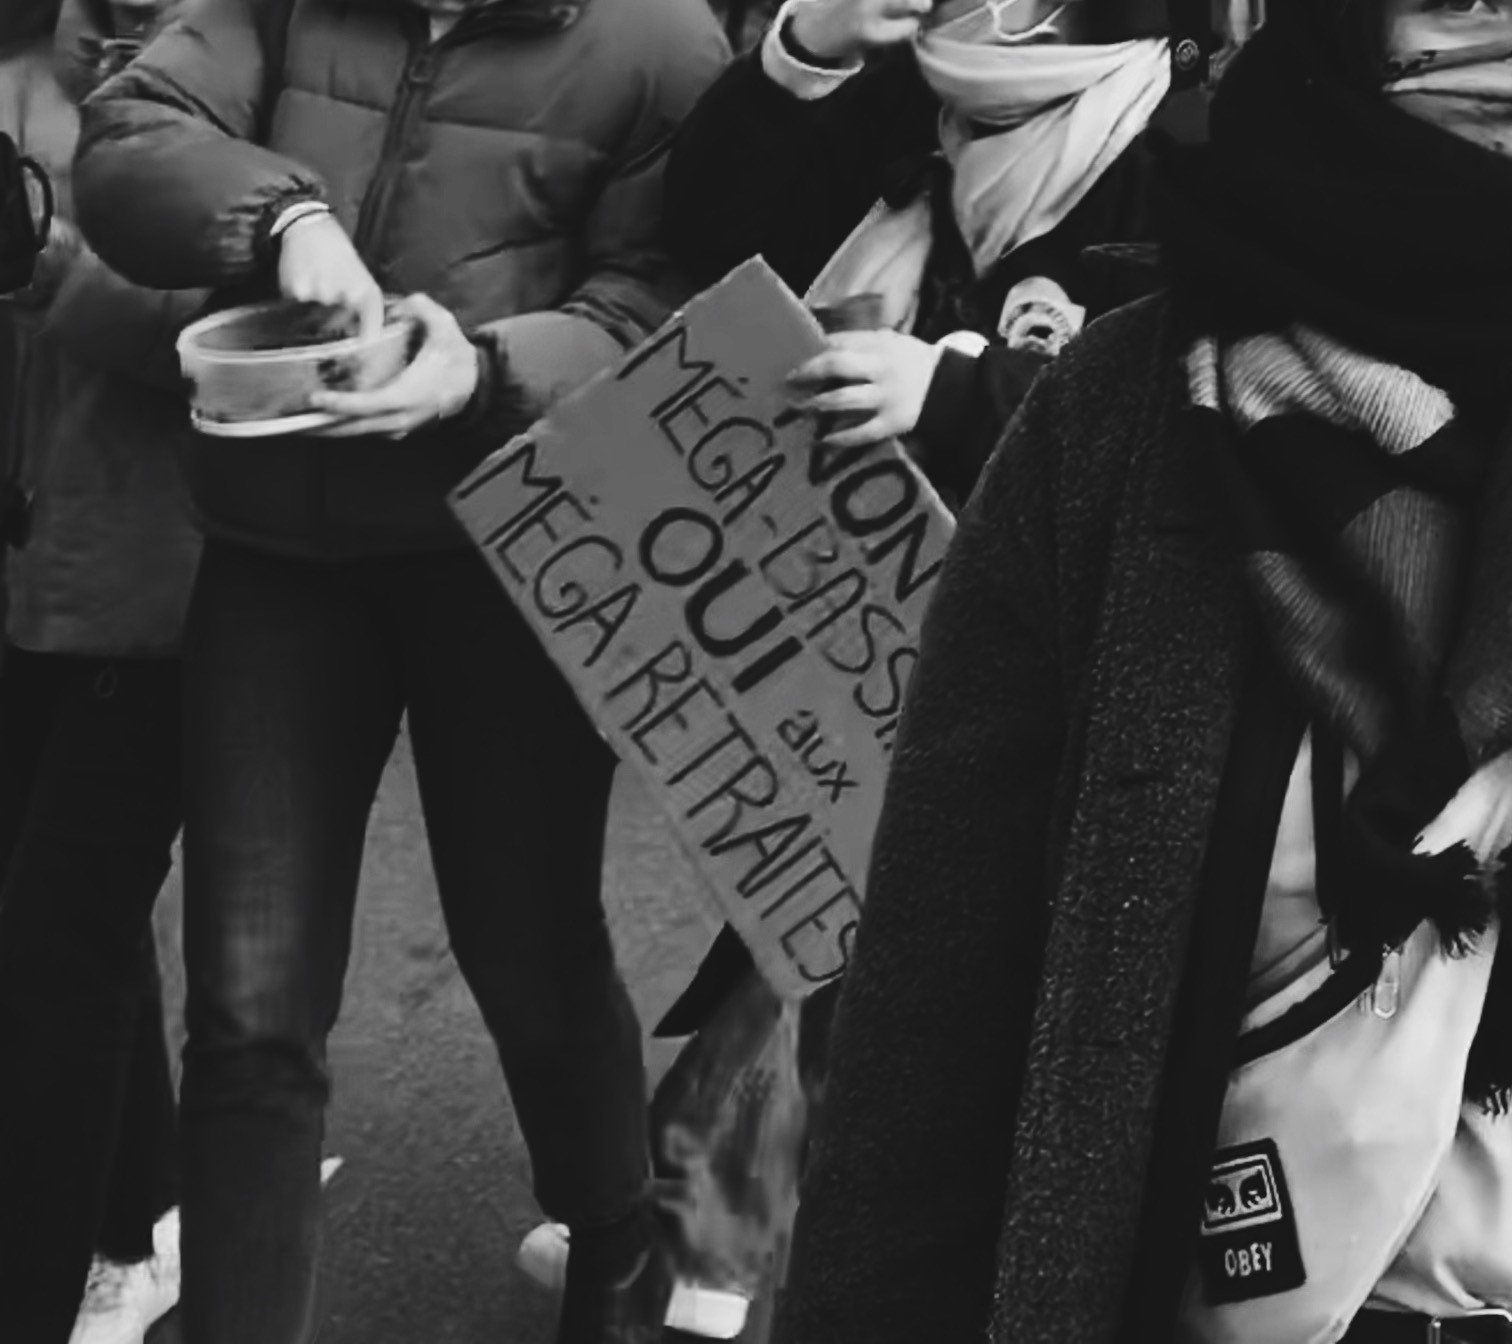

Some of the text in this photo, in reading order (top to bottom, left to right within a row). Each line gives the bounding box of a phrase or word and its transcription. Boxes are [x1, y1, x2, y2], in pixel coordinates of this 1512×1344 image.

[458, 443, 640, 668] MÉGA
[617, 325, 919, 750] MÉGA-BASS
[639, 508, 860, 803] OUI aux
[1225, 1242, 1272, 1277] OBEY
